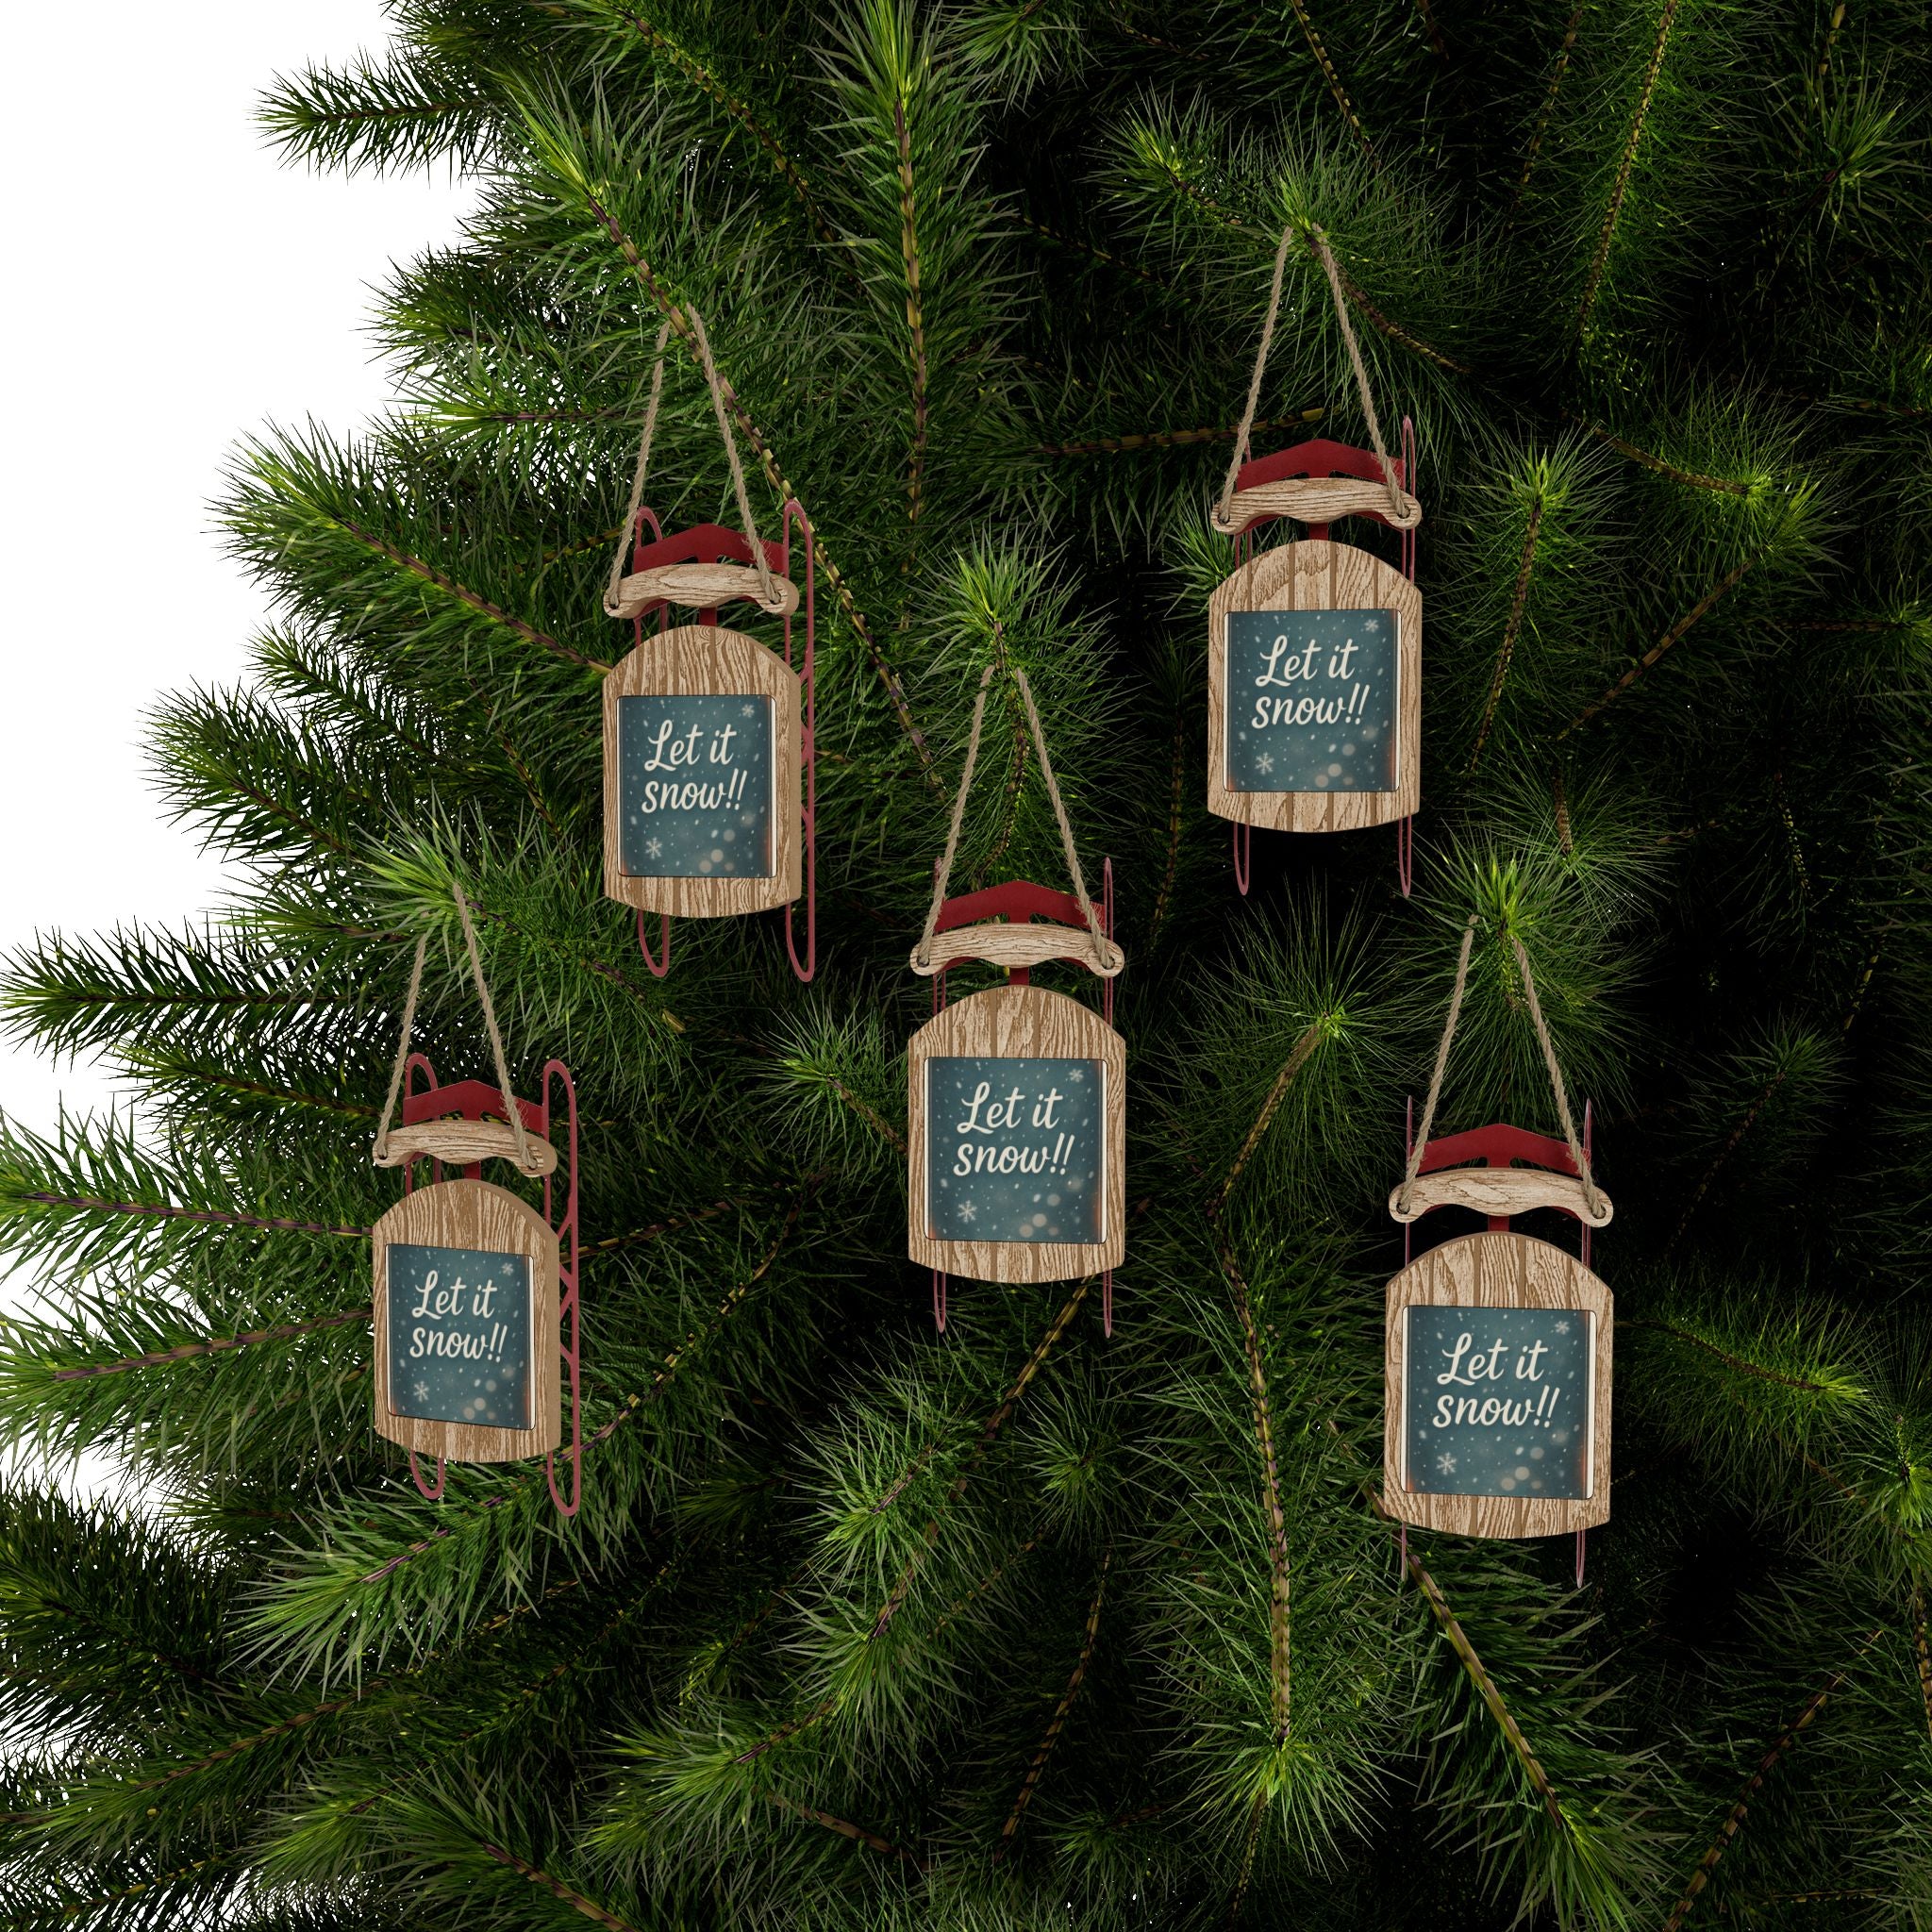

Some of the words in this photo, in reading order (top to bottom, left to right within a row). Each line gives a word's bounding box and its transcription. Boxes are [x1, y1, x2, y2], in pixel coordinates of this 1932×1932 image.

[1255, 634, 1323, 688] Let
[1327, 638, 1359, 680] it
[643, 719, 704, 772] Let
[709, 724, 738, 765] it
[957, 1081, 1026, 1135] Let
[1032, 1087, 1064, 1129] it
[411, 1270, 467, 1320] Let
[472, 1279, 498, 1319] it
[1437, 1332, 1509, 1386] Let
[1515, 1339, 1549, 1382] it
